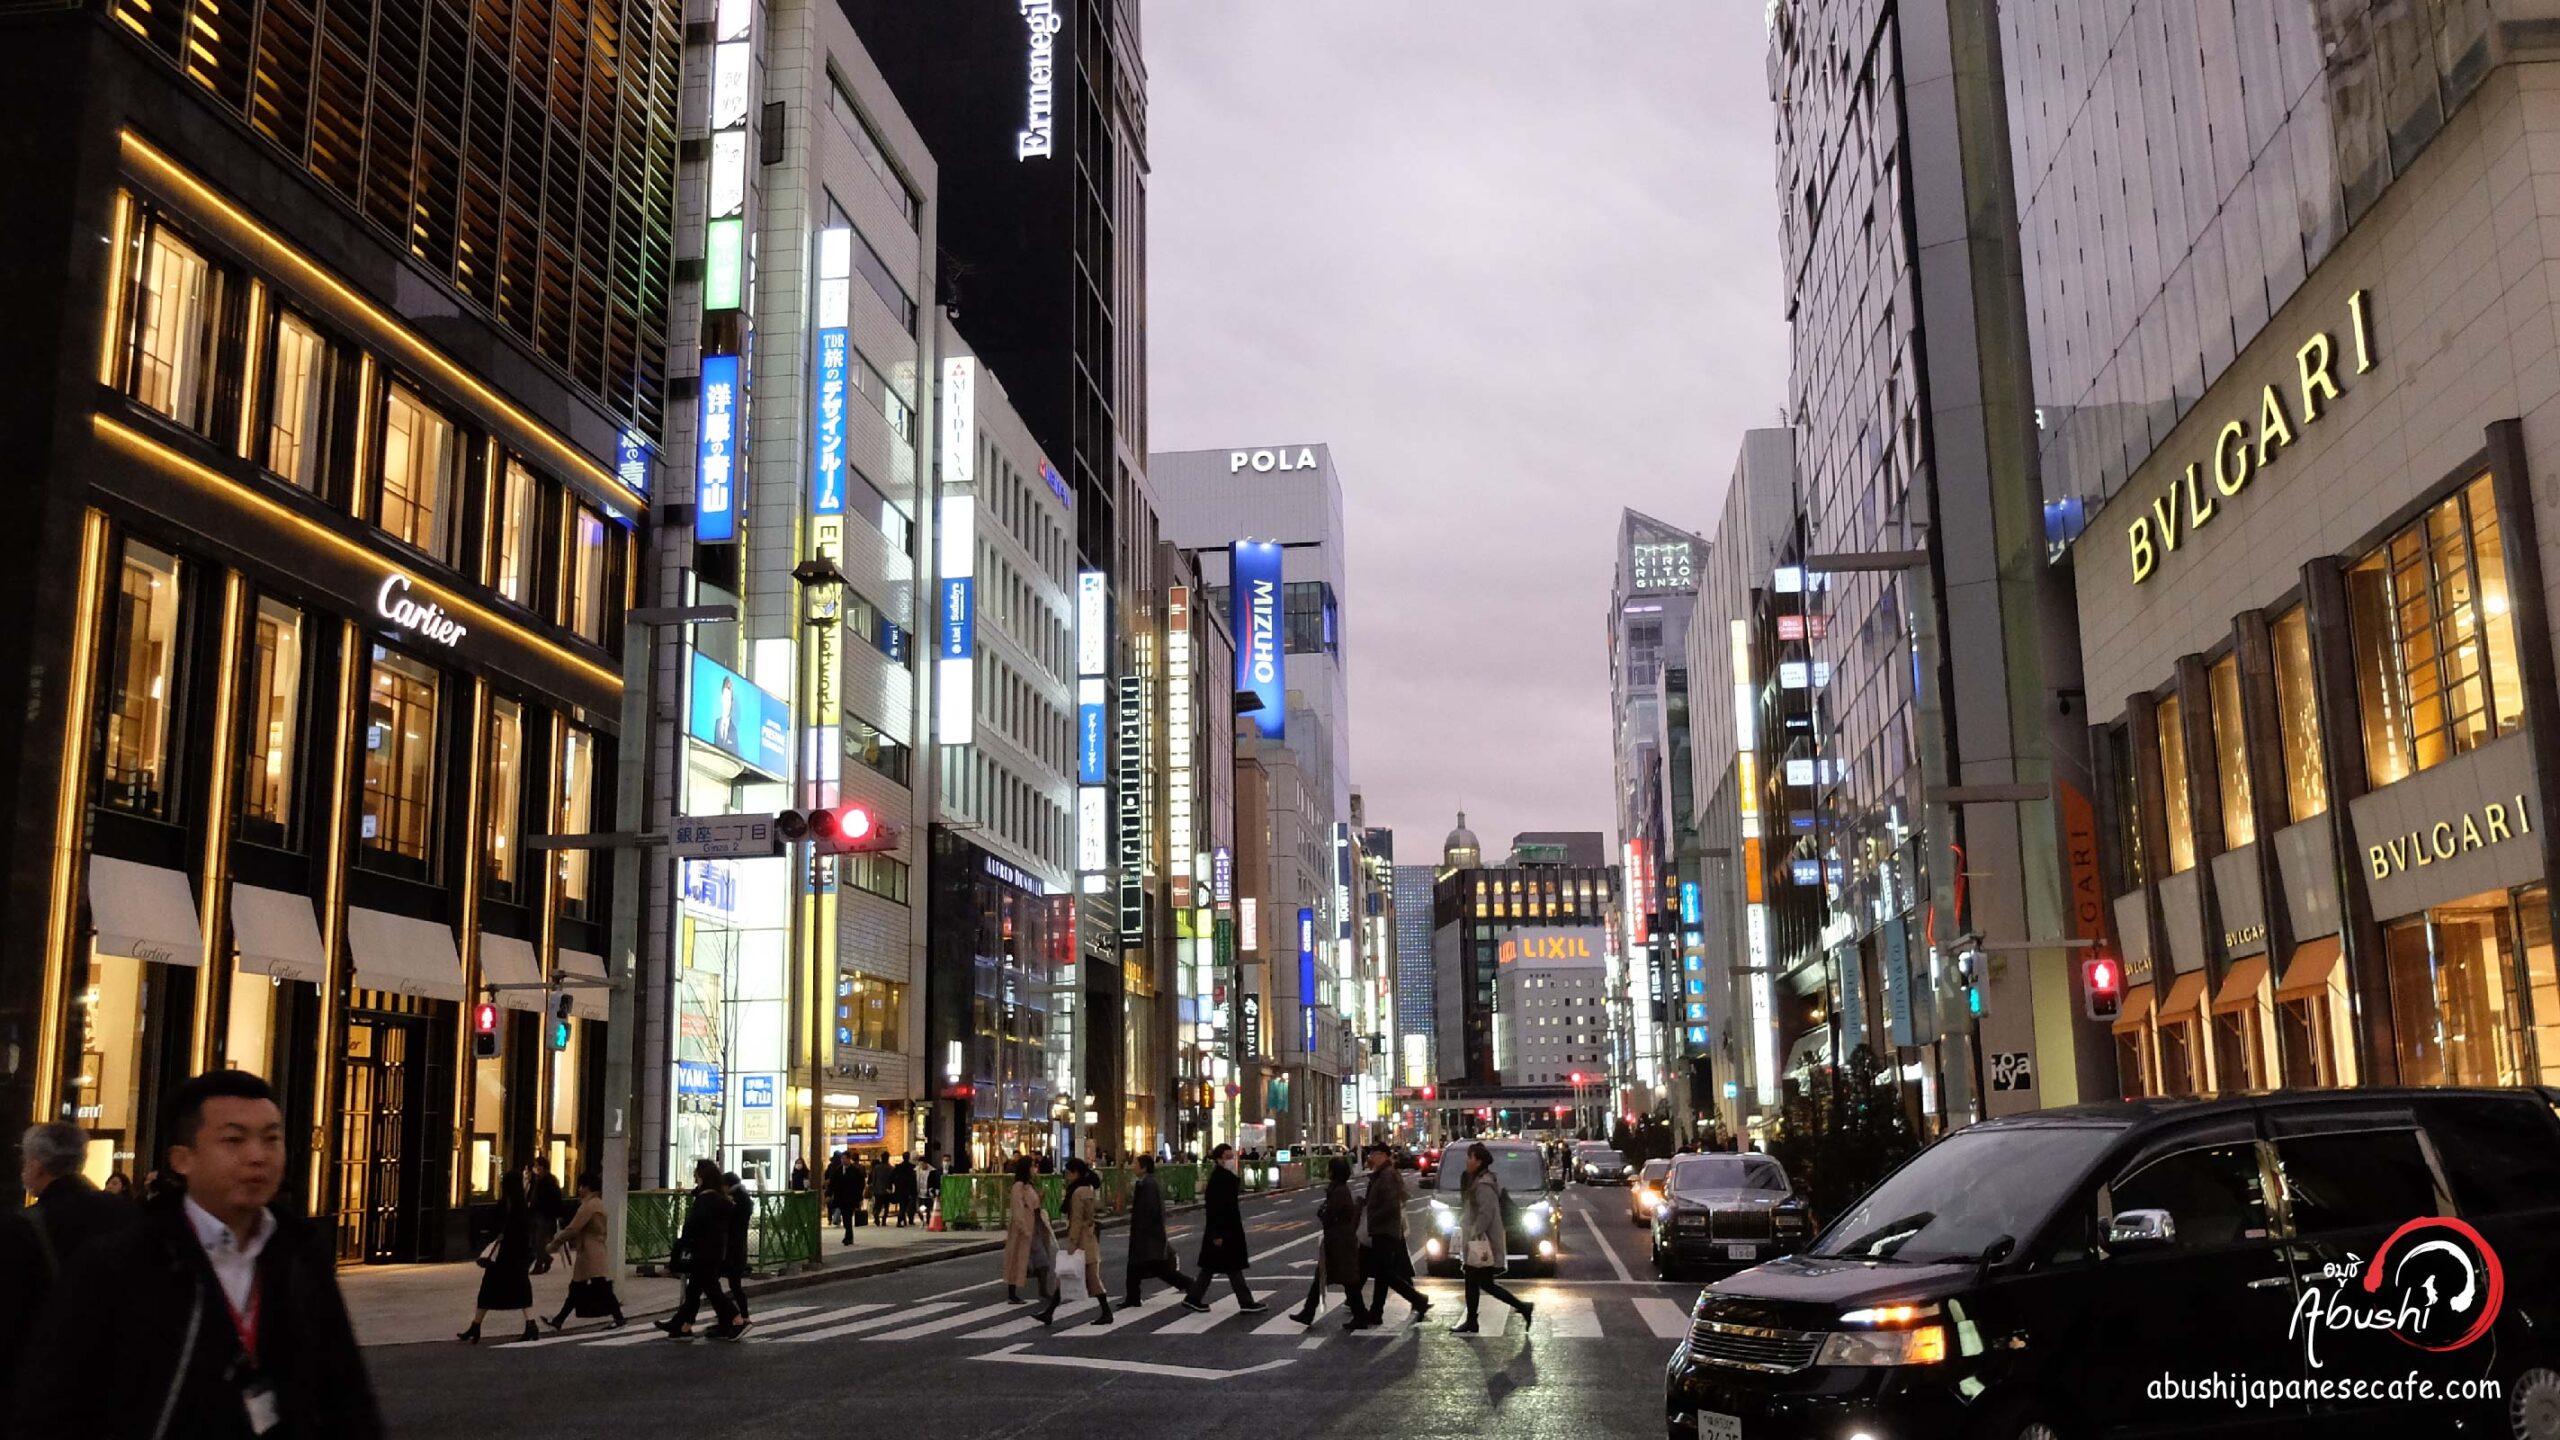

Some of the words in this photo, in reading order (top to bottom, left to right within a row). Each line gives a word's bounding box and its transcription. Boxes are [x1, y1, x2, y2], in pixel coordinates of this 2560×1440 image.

[702, 383, 732, 513] 洋服の青山
[2128, 289, 2370, 585] BVLGARI
[1230, 448, 1317, 473] POLA
[1636, 577, 1690, 588] GINZA
[377, 573, 467, 647] Cartier
[1253, 579, 1274, 684] MIZUHO
[677, 823, 767, 844] 銀座二丁目
[2368, 794, 2530, 881] BVLGARI
[703, 843, 729, 853] Ginza
[733, 843, 739, 851] 2
[131, 939, 173, 961] Cartier
[1523, 936, 1590, 960] LIXIL
[267, 959, 302, 978] Cartier
